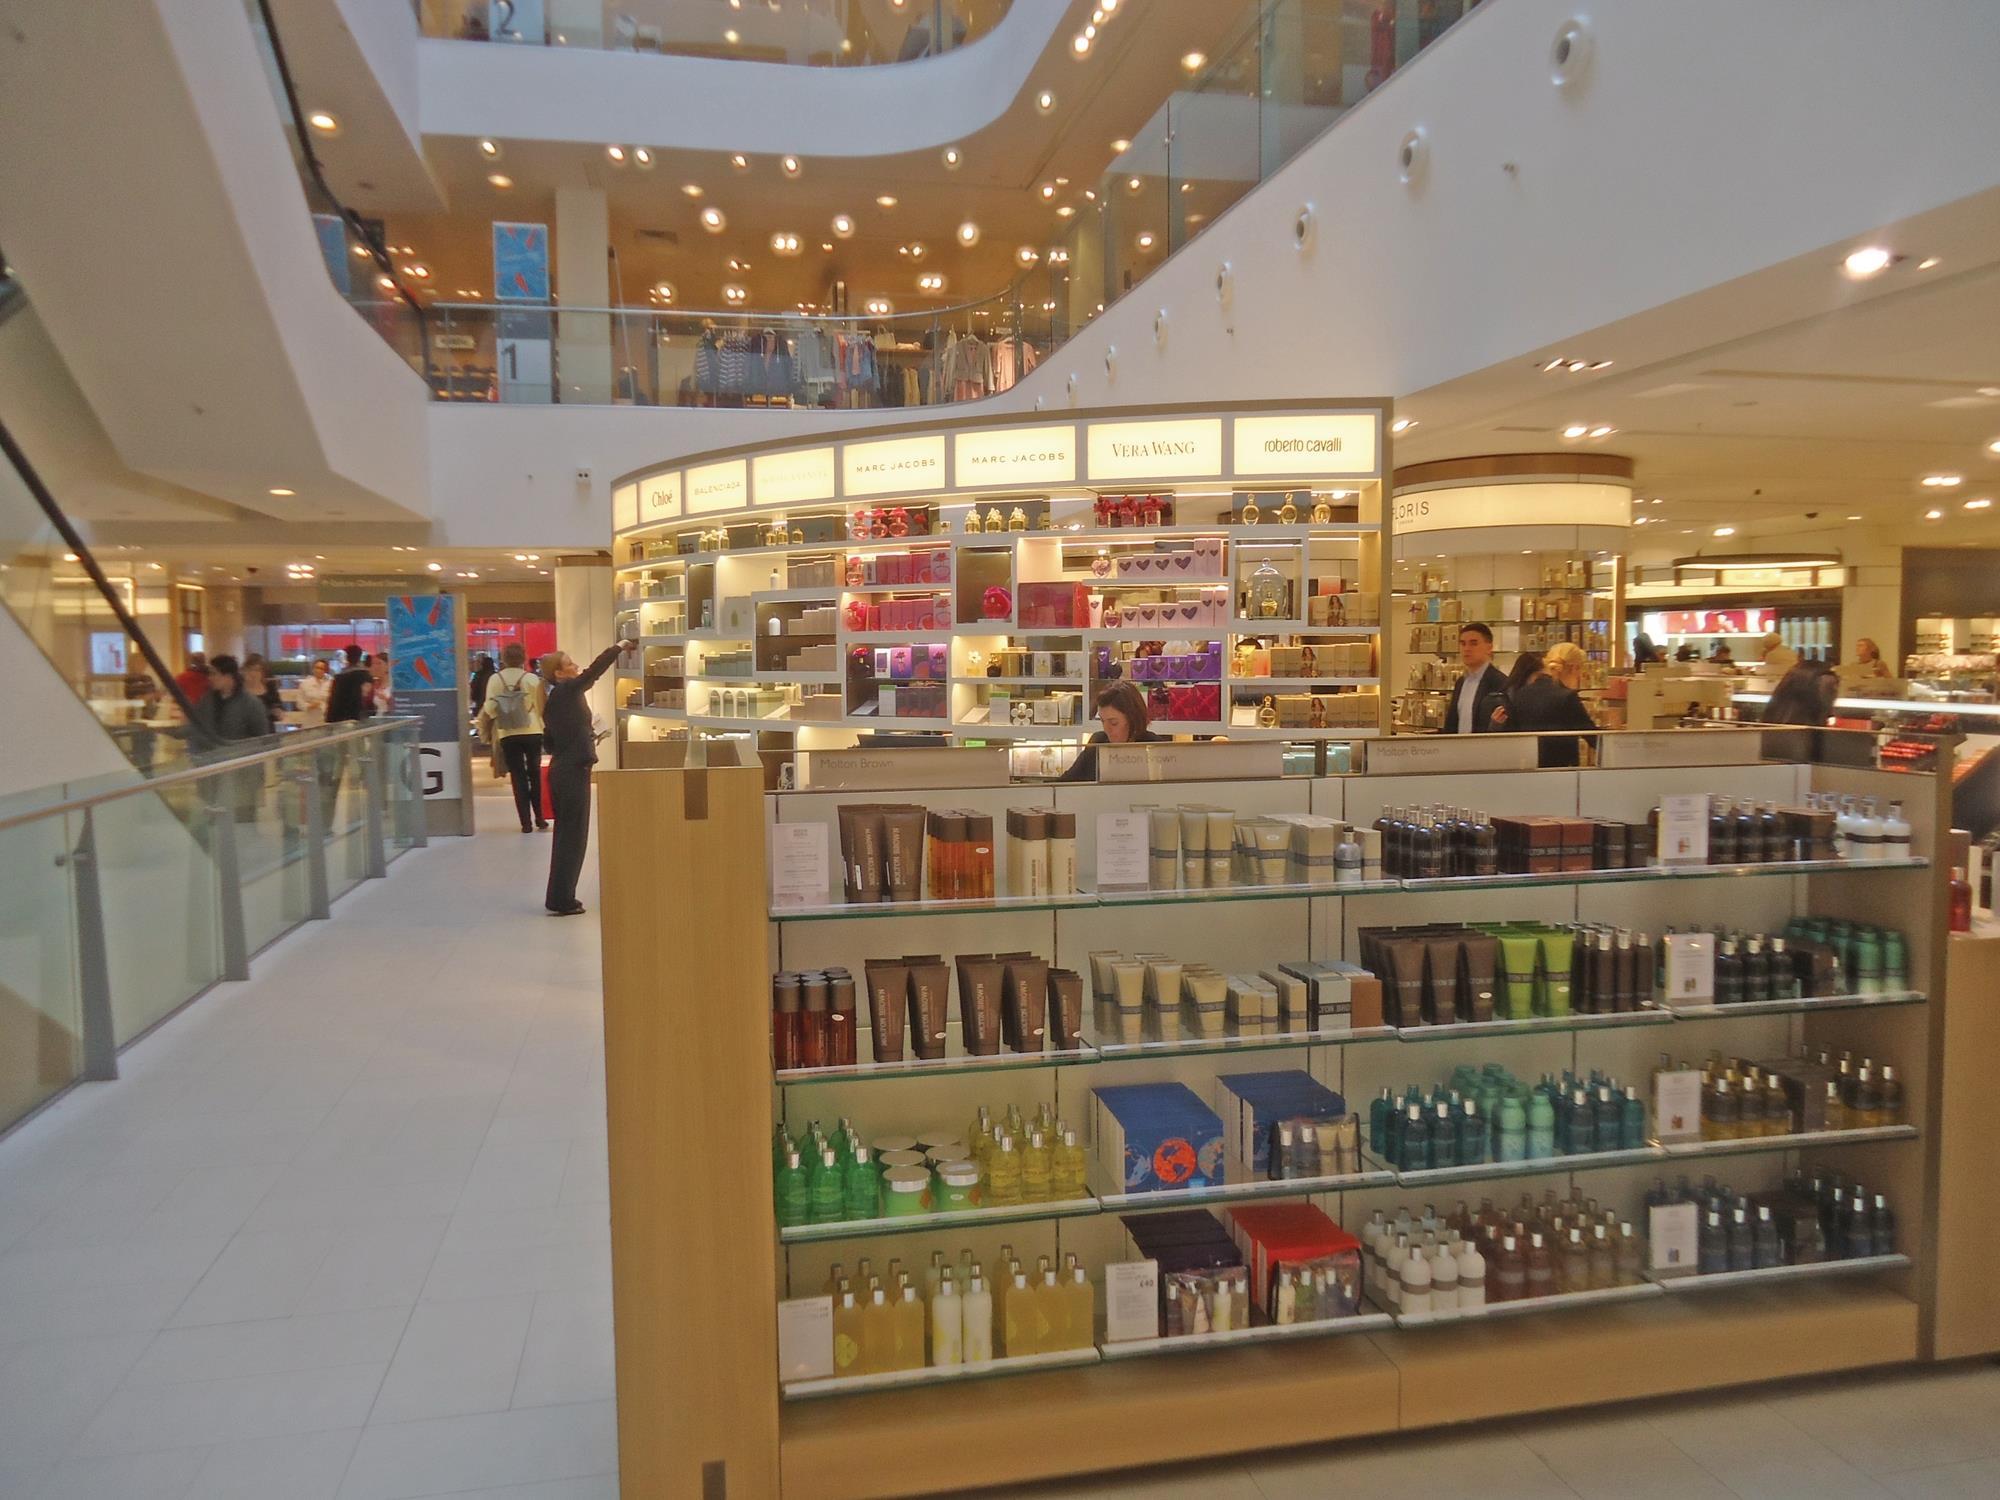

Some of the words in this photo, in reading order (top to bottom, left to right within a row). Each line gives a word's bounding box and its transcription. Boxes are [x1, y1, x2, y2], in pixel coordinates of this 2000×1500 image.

[501, 342, 518, 380] 1
[1111, 443, 1149, 458] VERA
[1151, 441, 1196, 456] WANG
[1264, 438, 1304, 453] roberto
[1306, 437, 1342, 453] cavalli
[856, 463, 886, 473] MARC
[890, 458, 936, 471] JACOBS
[972, 455, 1006, 465] MARC
[1012, 452, 1066, 463] JACOBS
[651, 490, 674, 509] Chloé
[820, 758, 858, 769] Molton
[860, 757, 894, 769] Brown
